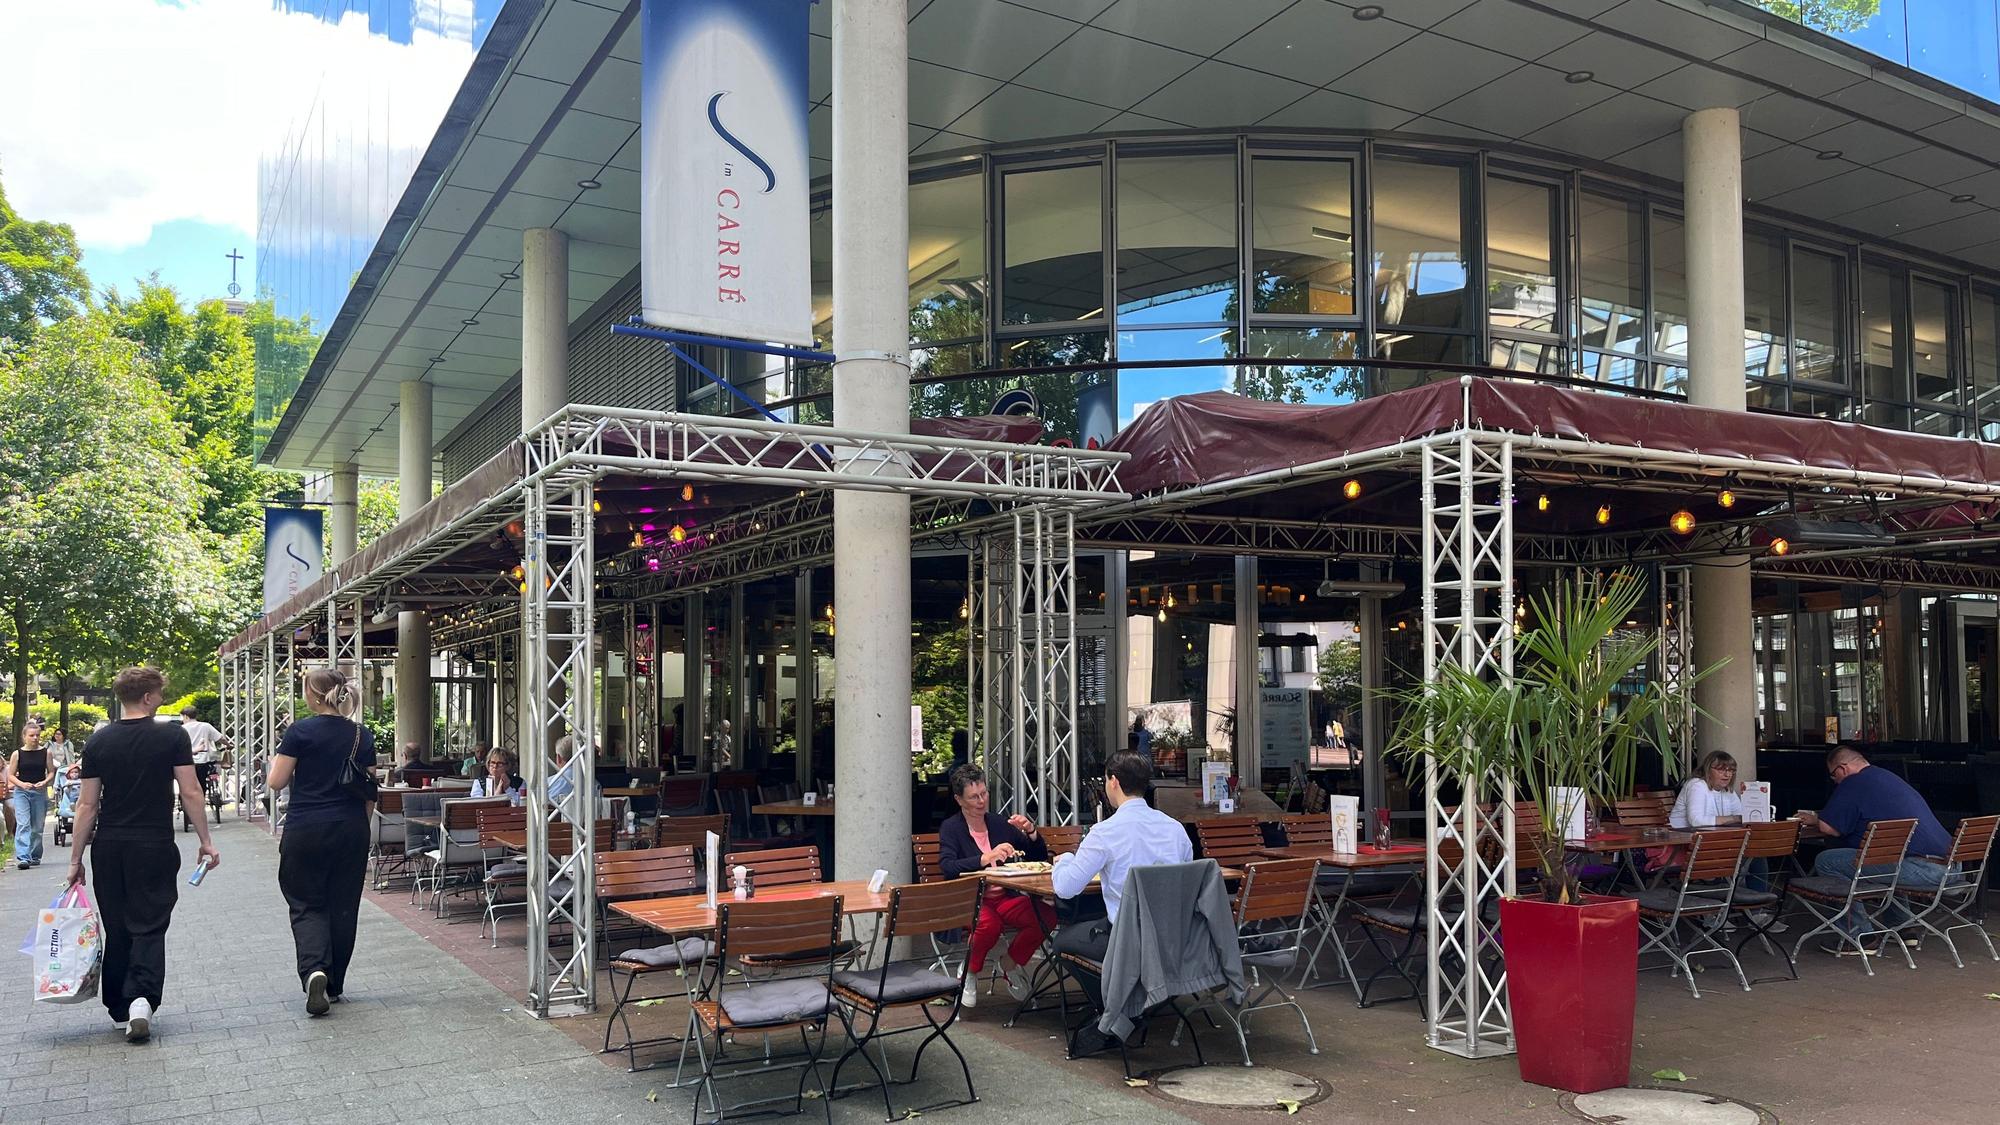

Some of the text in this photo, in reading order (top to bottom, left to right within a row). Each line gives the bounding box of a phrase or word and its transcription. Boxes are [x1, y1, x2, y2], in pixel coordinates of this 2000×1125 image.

[706, 90, 777, 304] S im CARRÉ
[50, 928, 59, 958] ACTION
